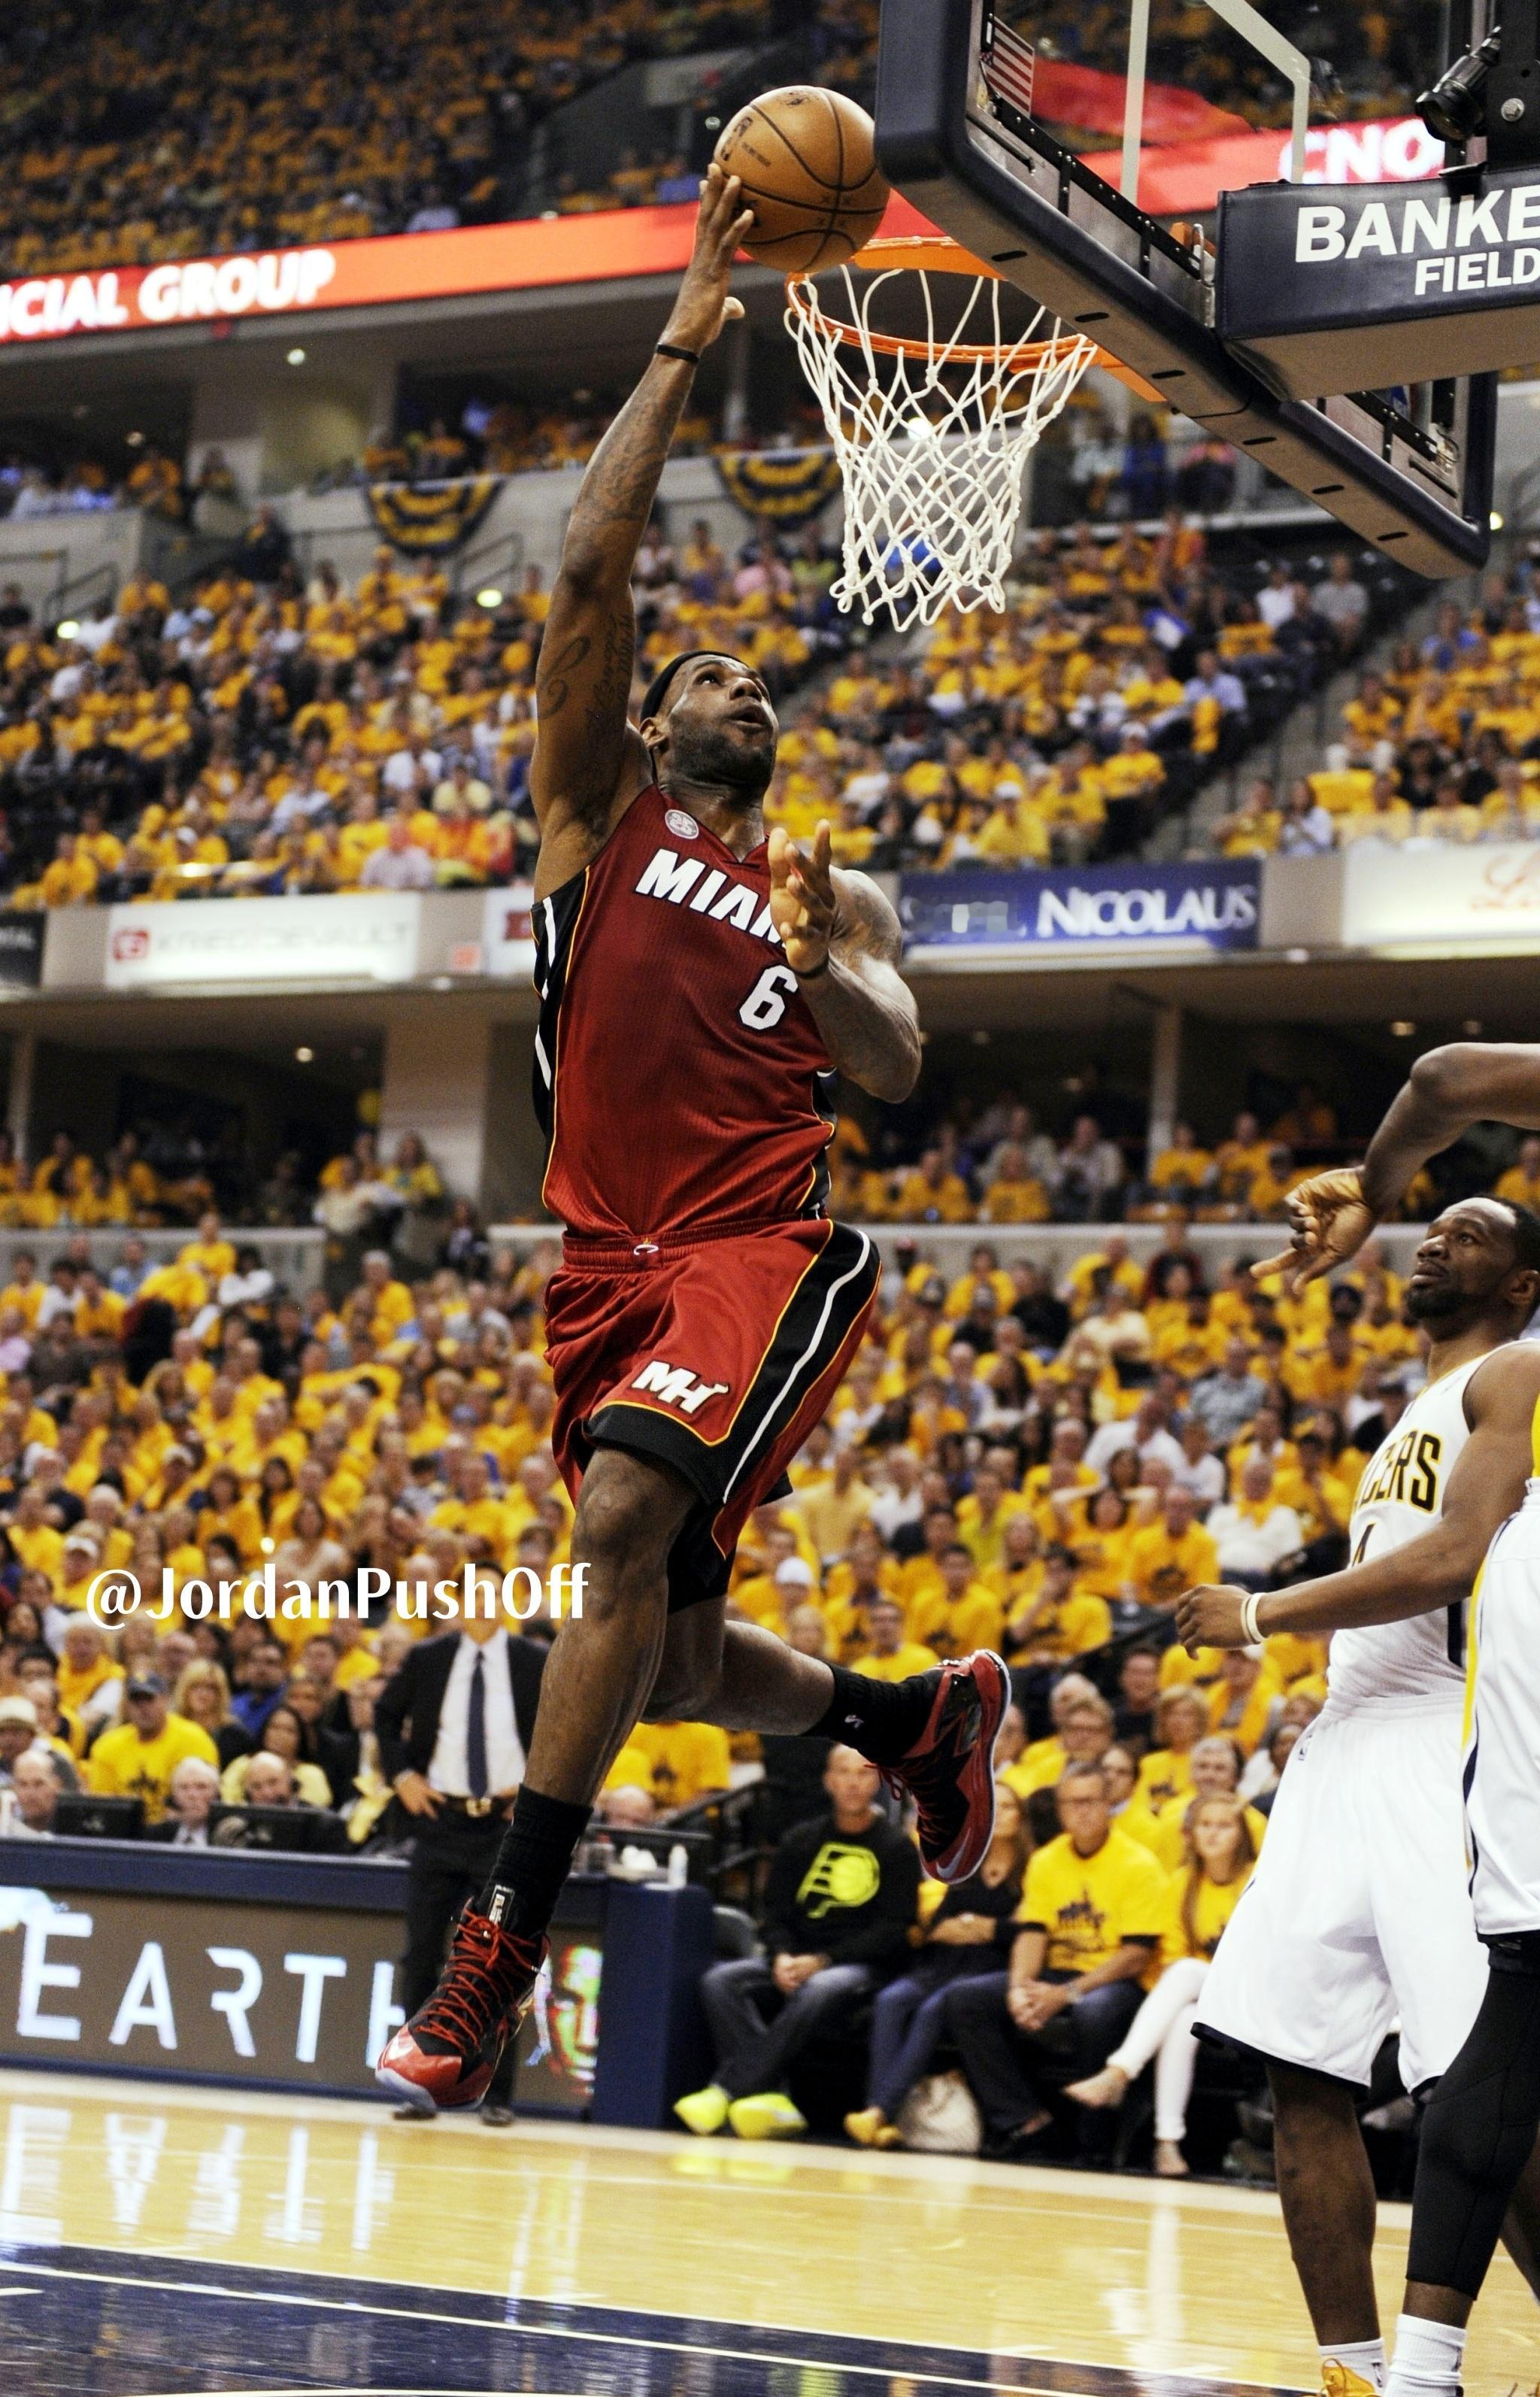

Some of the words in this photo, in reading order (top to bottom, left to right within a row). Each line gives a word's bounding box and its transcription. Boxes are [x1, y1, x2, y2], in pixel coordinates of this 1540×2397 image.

[1296, 185, 1540, 262] BANKE
[138, 249, 335, 322] GROUP
[1414, 247, 1540, 296] FIELD
[1038, 884, 1257, 938] NICOLAUS
[739, 965, 799, 1030] 6
